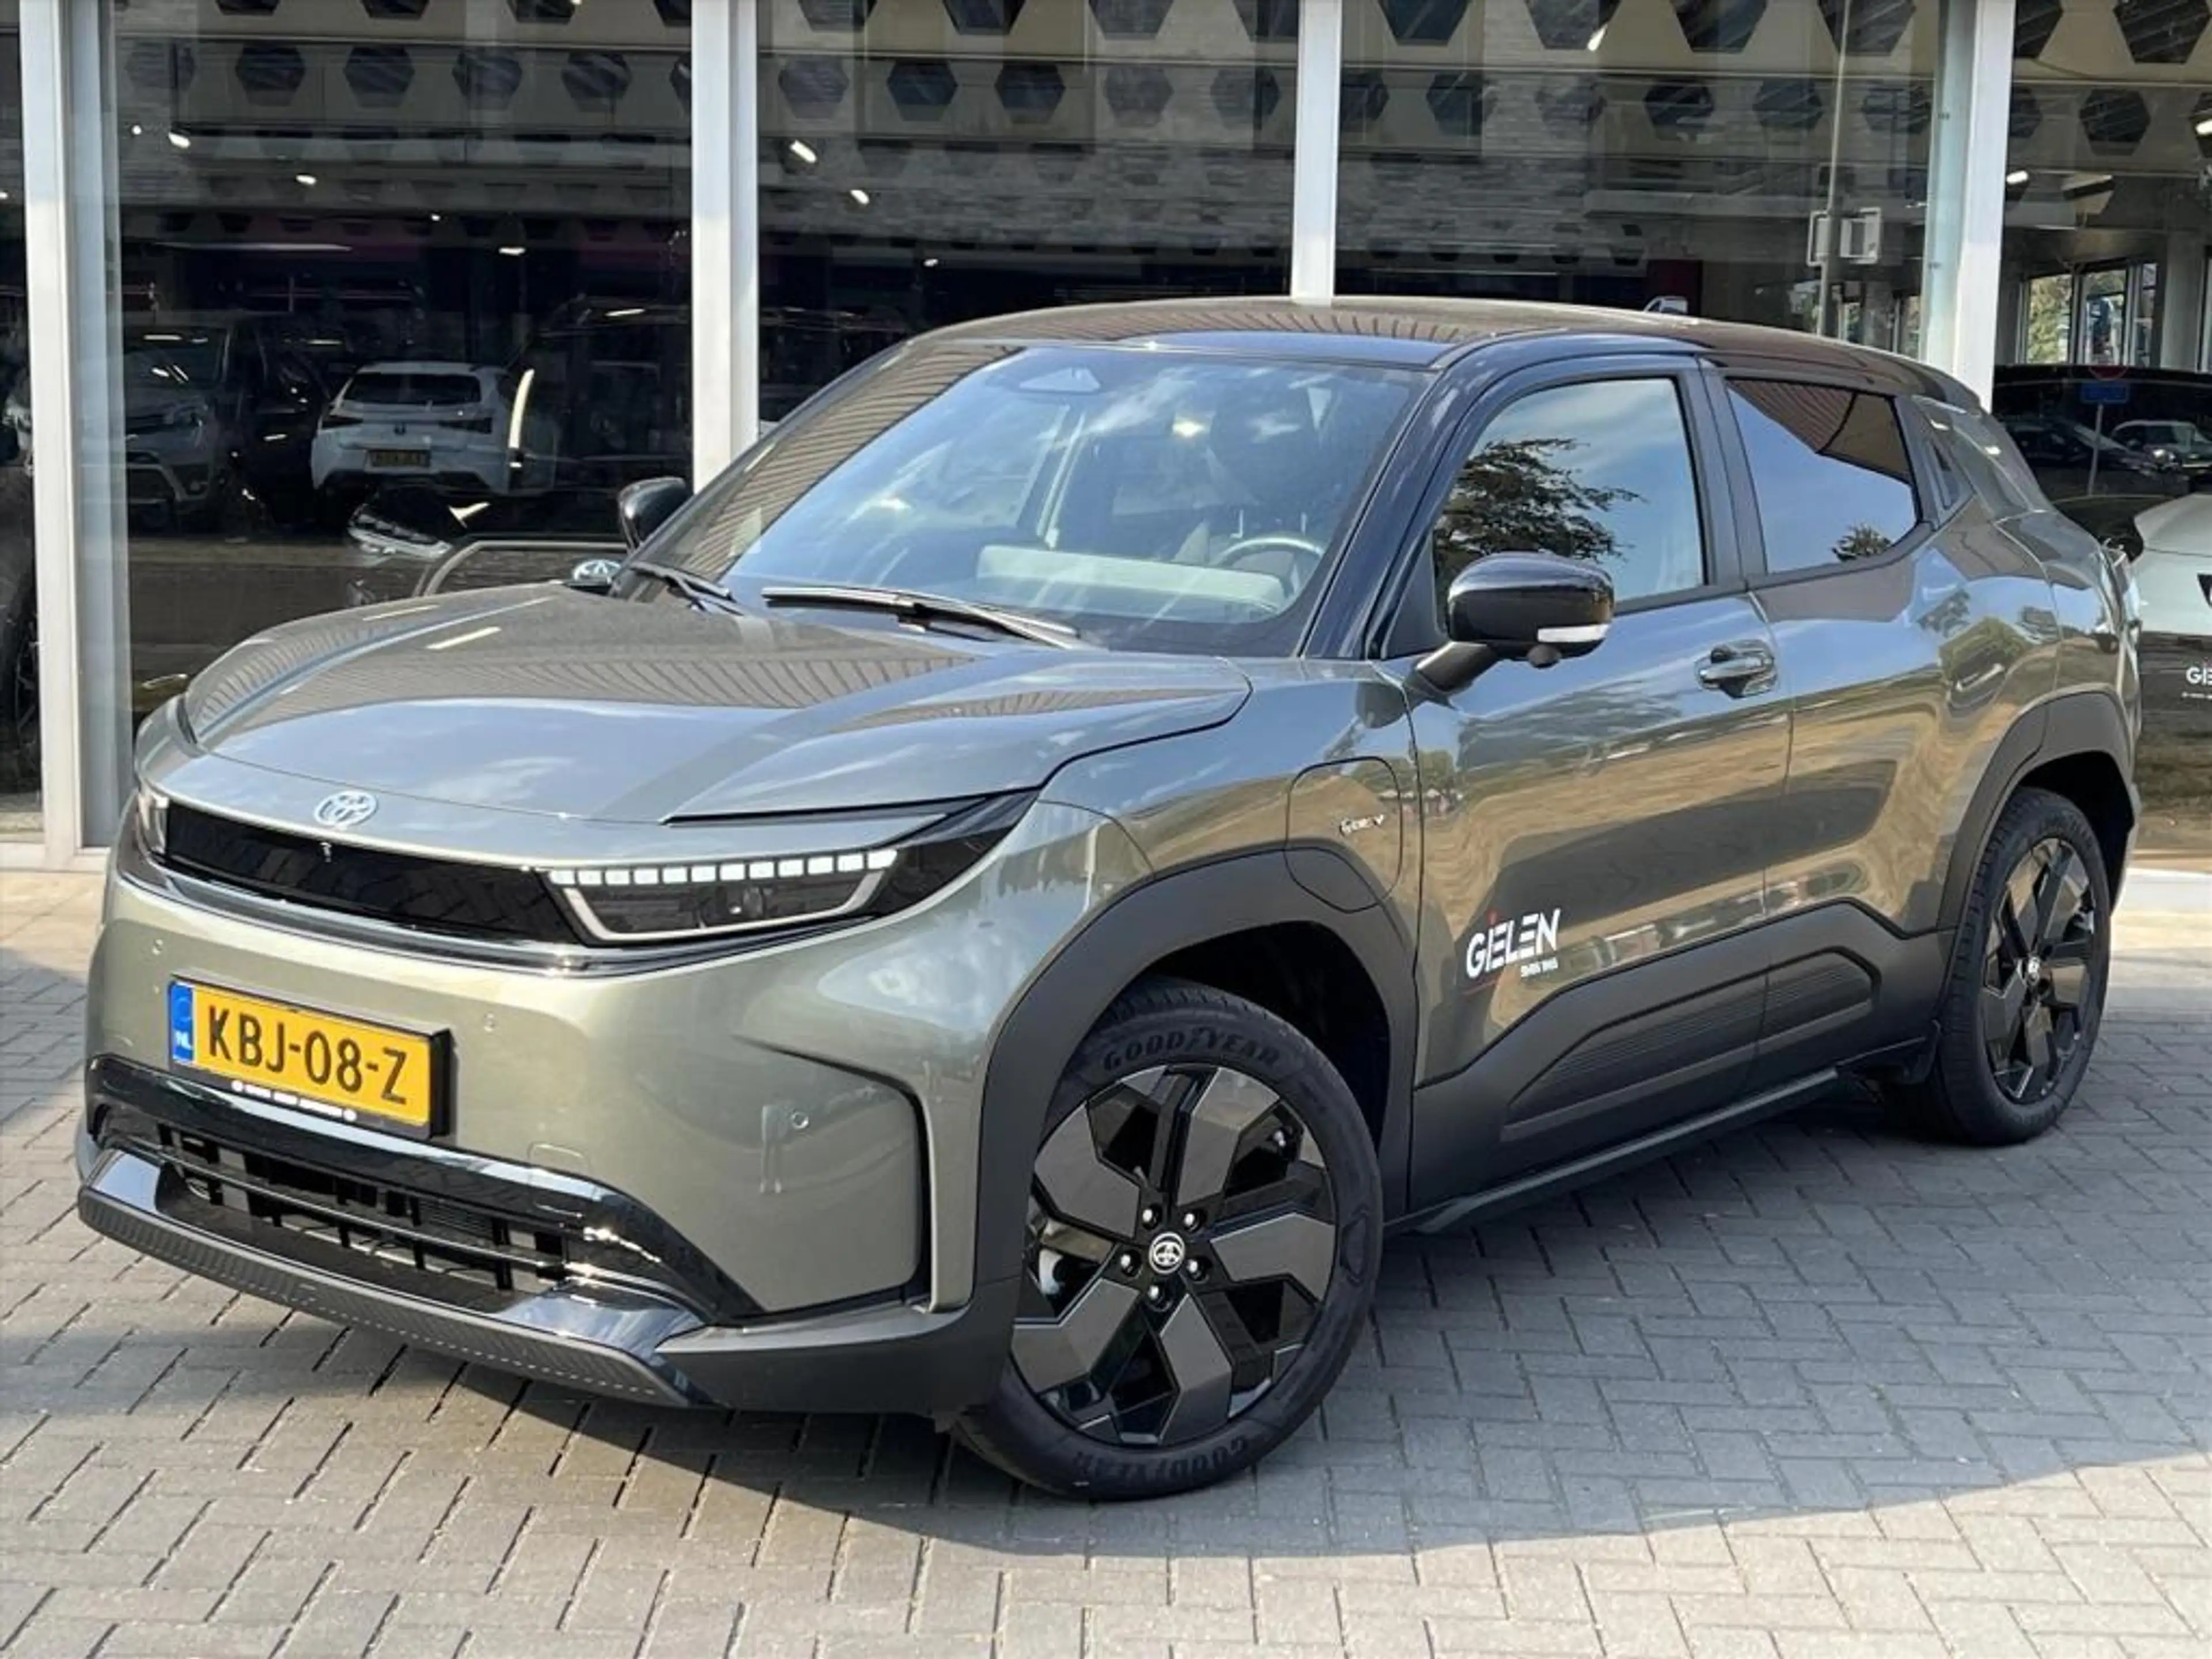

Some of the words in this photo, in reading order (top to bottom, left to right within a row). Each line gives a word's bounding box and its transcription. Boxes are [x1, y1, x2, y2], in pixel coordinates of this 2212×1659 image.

[1466, 908, 1561, 978] GIELEN
[209, 1005, 407, 1105] KBJ-08-Z
[1103, 1027, 1281, 1071] GOODYEAR
